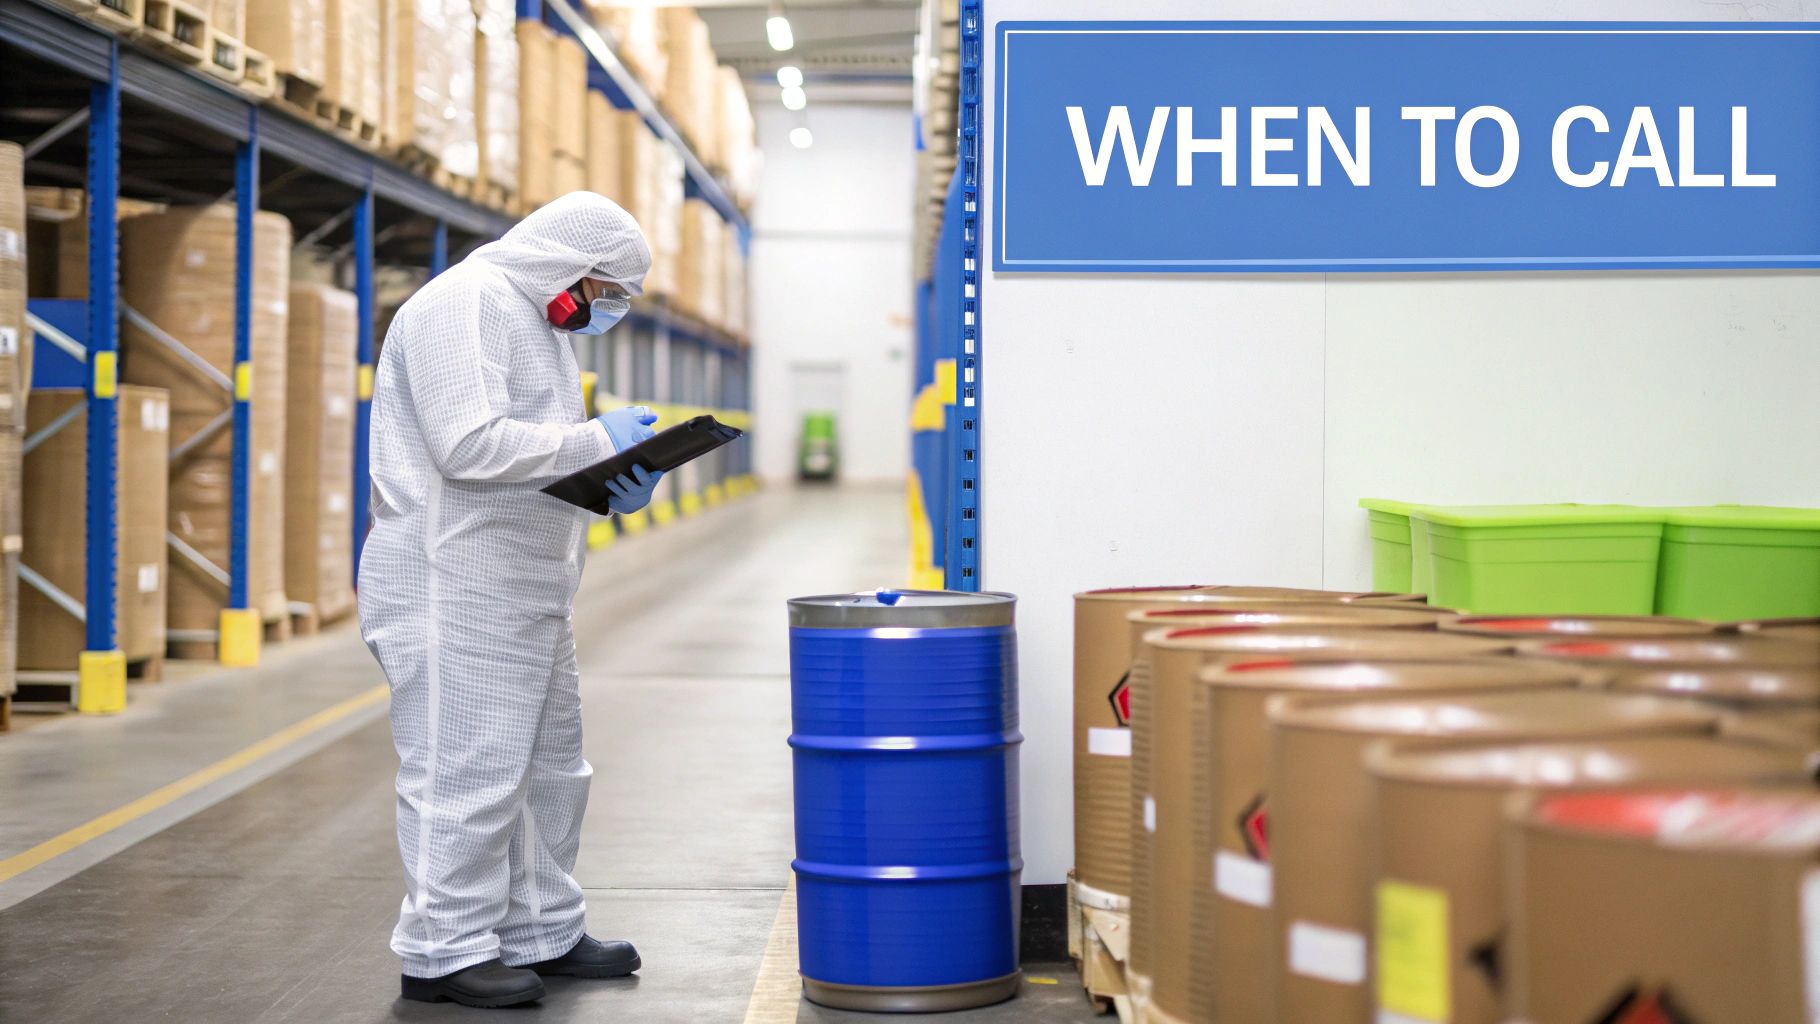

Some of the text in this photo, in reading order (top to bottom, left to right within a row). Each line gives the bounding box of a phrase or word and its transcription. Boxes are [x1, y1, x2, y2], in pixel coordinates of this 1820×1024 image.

[1066, 105, 1777, 188] WHEN TO CALL
